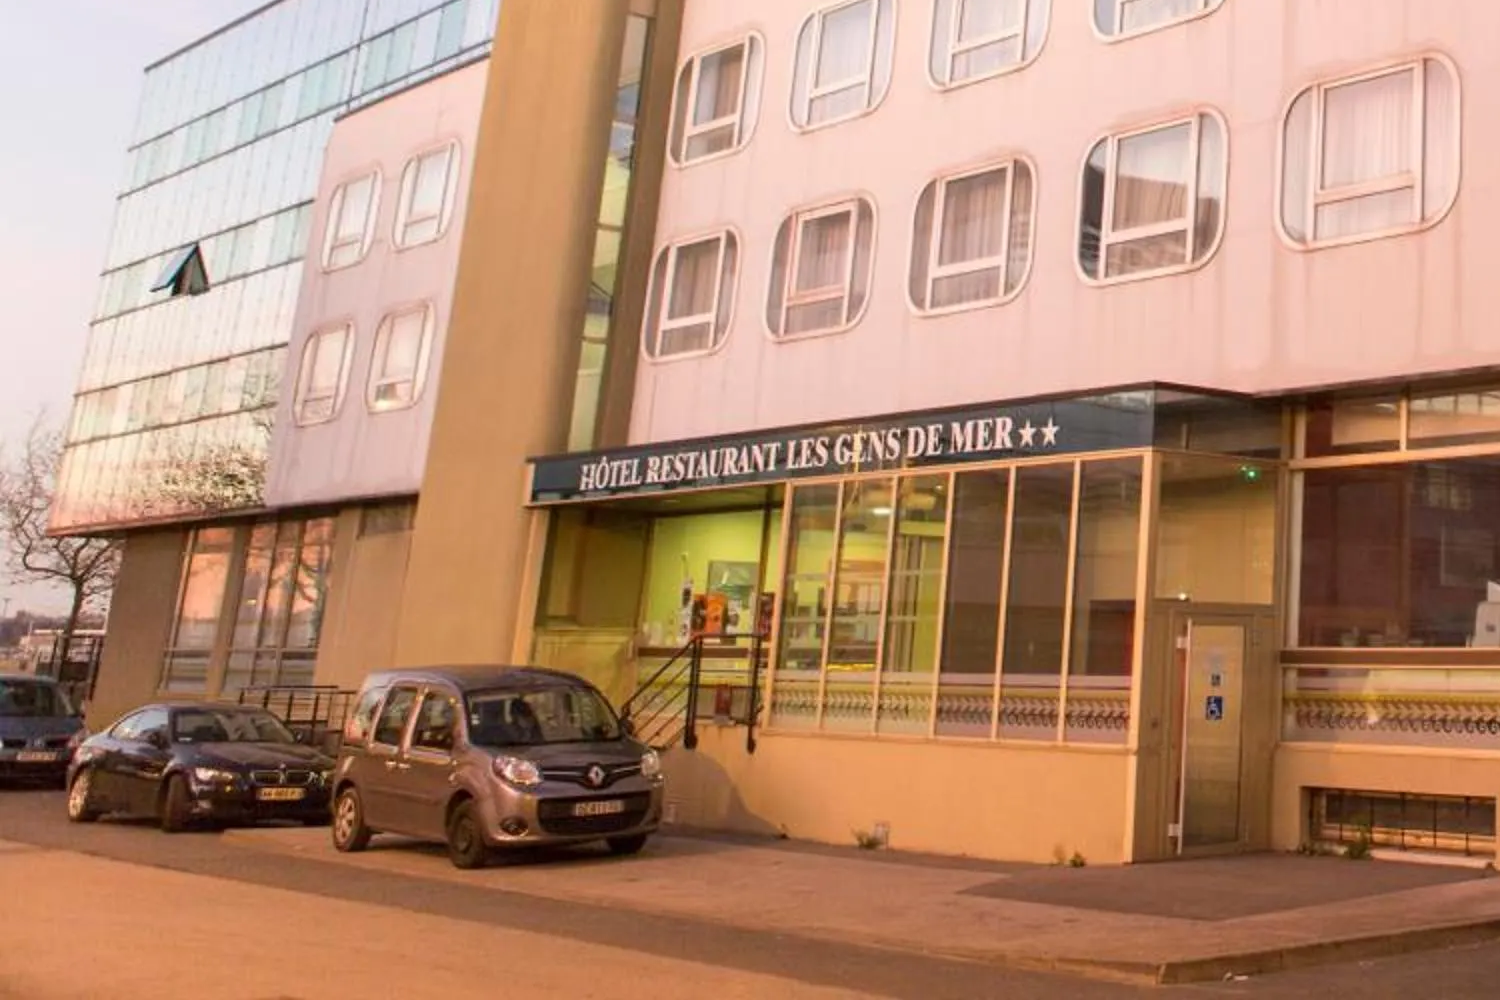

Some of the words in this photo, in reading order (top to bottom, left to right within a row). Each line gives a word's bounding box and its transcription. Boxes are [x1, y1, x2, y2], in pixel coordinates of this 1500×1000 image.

[579, 456, 643, 491] HÔTEL
[645, 442, 781, 485] RESTAURANT
[786, 436, 830, 470] LES
[834, 427, 901, 466] GENS
[906, 424, 944, 458] DE
[950, 416, 1014, 454] MER
